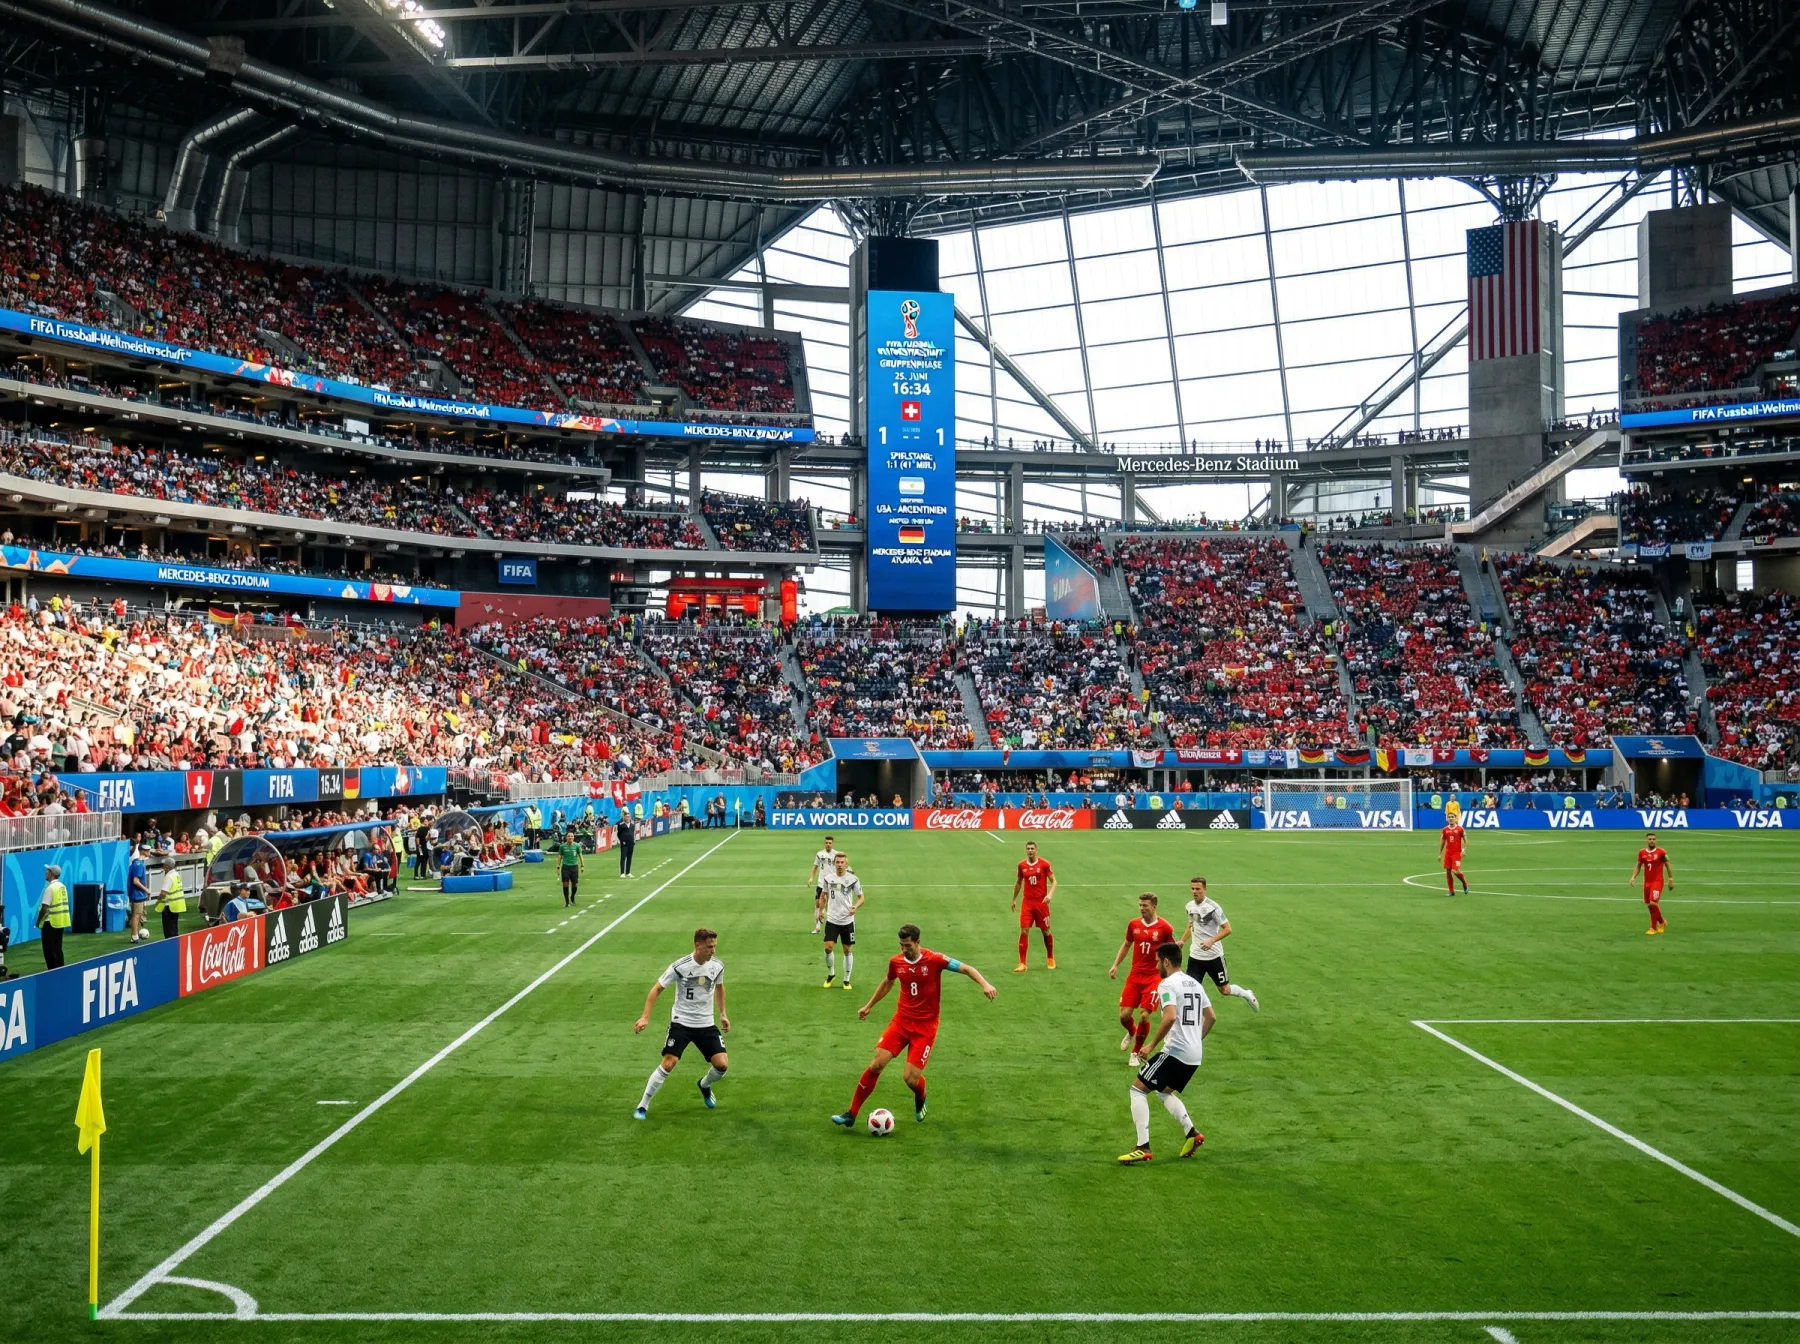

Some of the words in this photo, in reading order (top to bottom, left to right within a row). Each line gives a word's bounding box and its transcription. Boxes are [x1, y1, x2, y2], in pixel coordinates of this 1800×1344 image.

[30, 318, 54, 335] FIFA
[892, 382, 931, 396] 16:34
[1693, 409, 1715, 420] FIFA
[878, 426, 887, 445] 1
[935, 427, 944, 446] 1
[1116, 456, 1232, 472] Mercedes-Benz
[1236, 456, 1300, 471] Stadium
[158, 567, 231, 586] MERCEDES-BENZ
[231, 574, 270, 588] STADIUM
[503, 564, 533, 577] FIFA
[99, 779, 135, 808] FIFA
[223, 776, 230, 801] 1
[269, 774, 294, 798] FIFA
[772, 812, 806, 826] FIFA
[809, 812, 869, 826] WORLD
[873, 812, 909, 826] COM
[1259, 810, 1312, 828] VISA
[1356, 810, 1406, 828] VISA
[1543, 810, 1594, 828] VISA
[1636, 810, 1688, 828] VISA
[1731, 810, 1783, 828] VISA
[1029, 875, 1037, 885] 10
[1139, 941, 1151, 954] 17
[1218, 971, 1225, 983] 5
[83, 957, 138, 1024] FIFA
[910, 982, 918, 996] 8
[922, 1045, 931, 1059] 8
